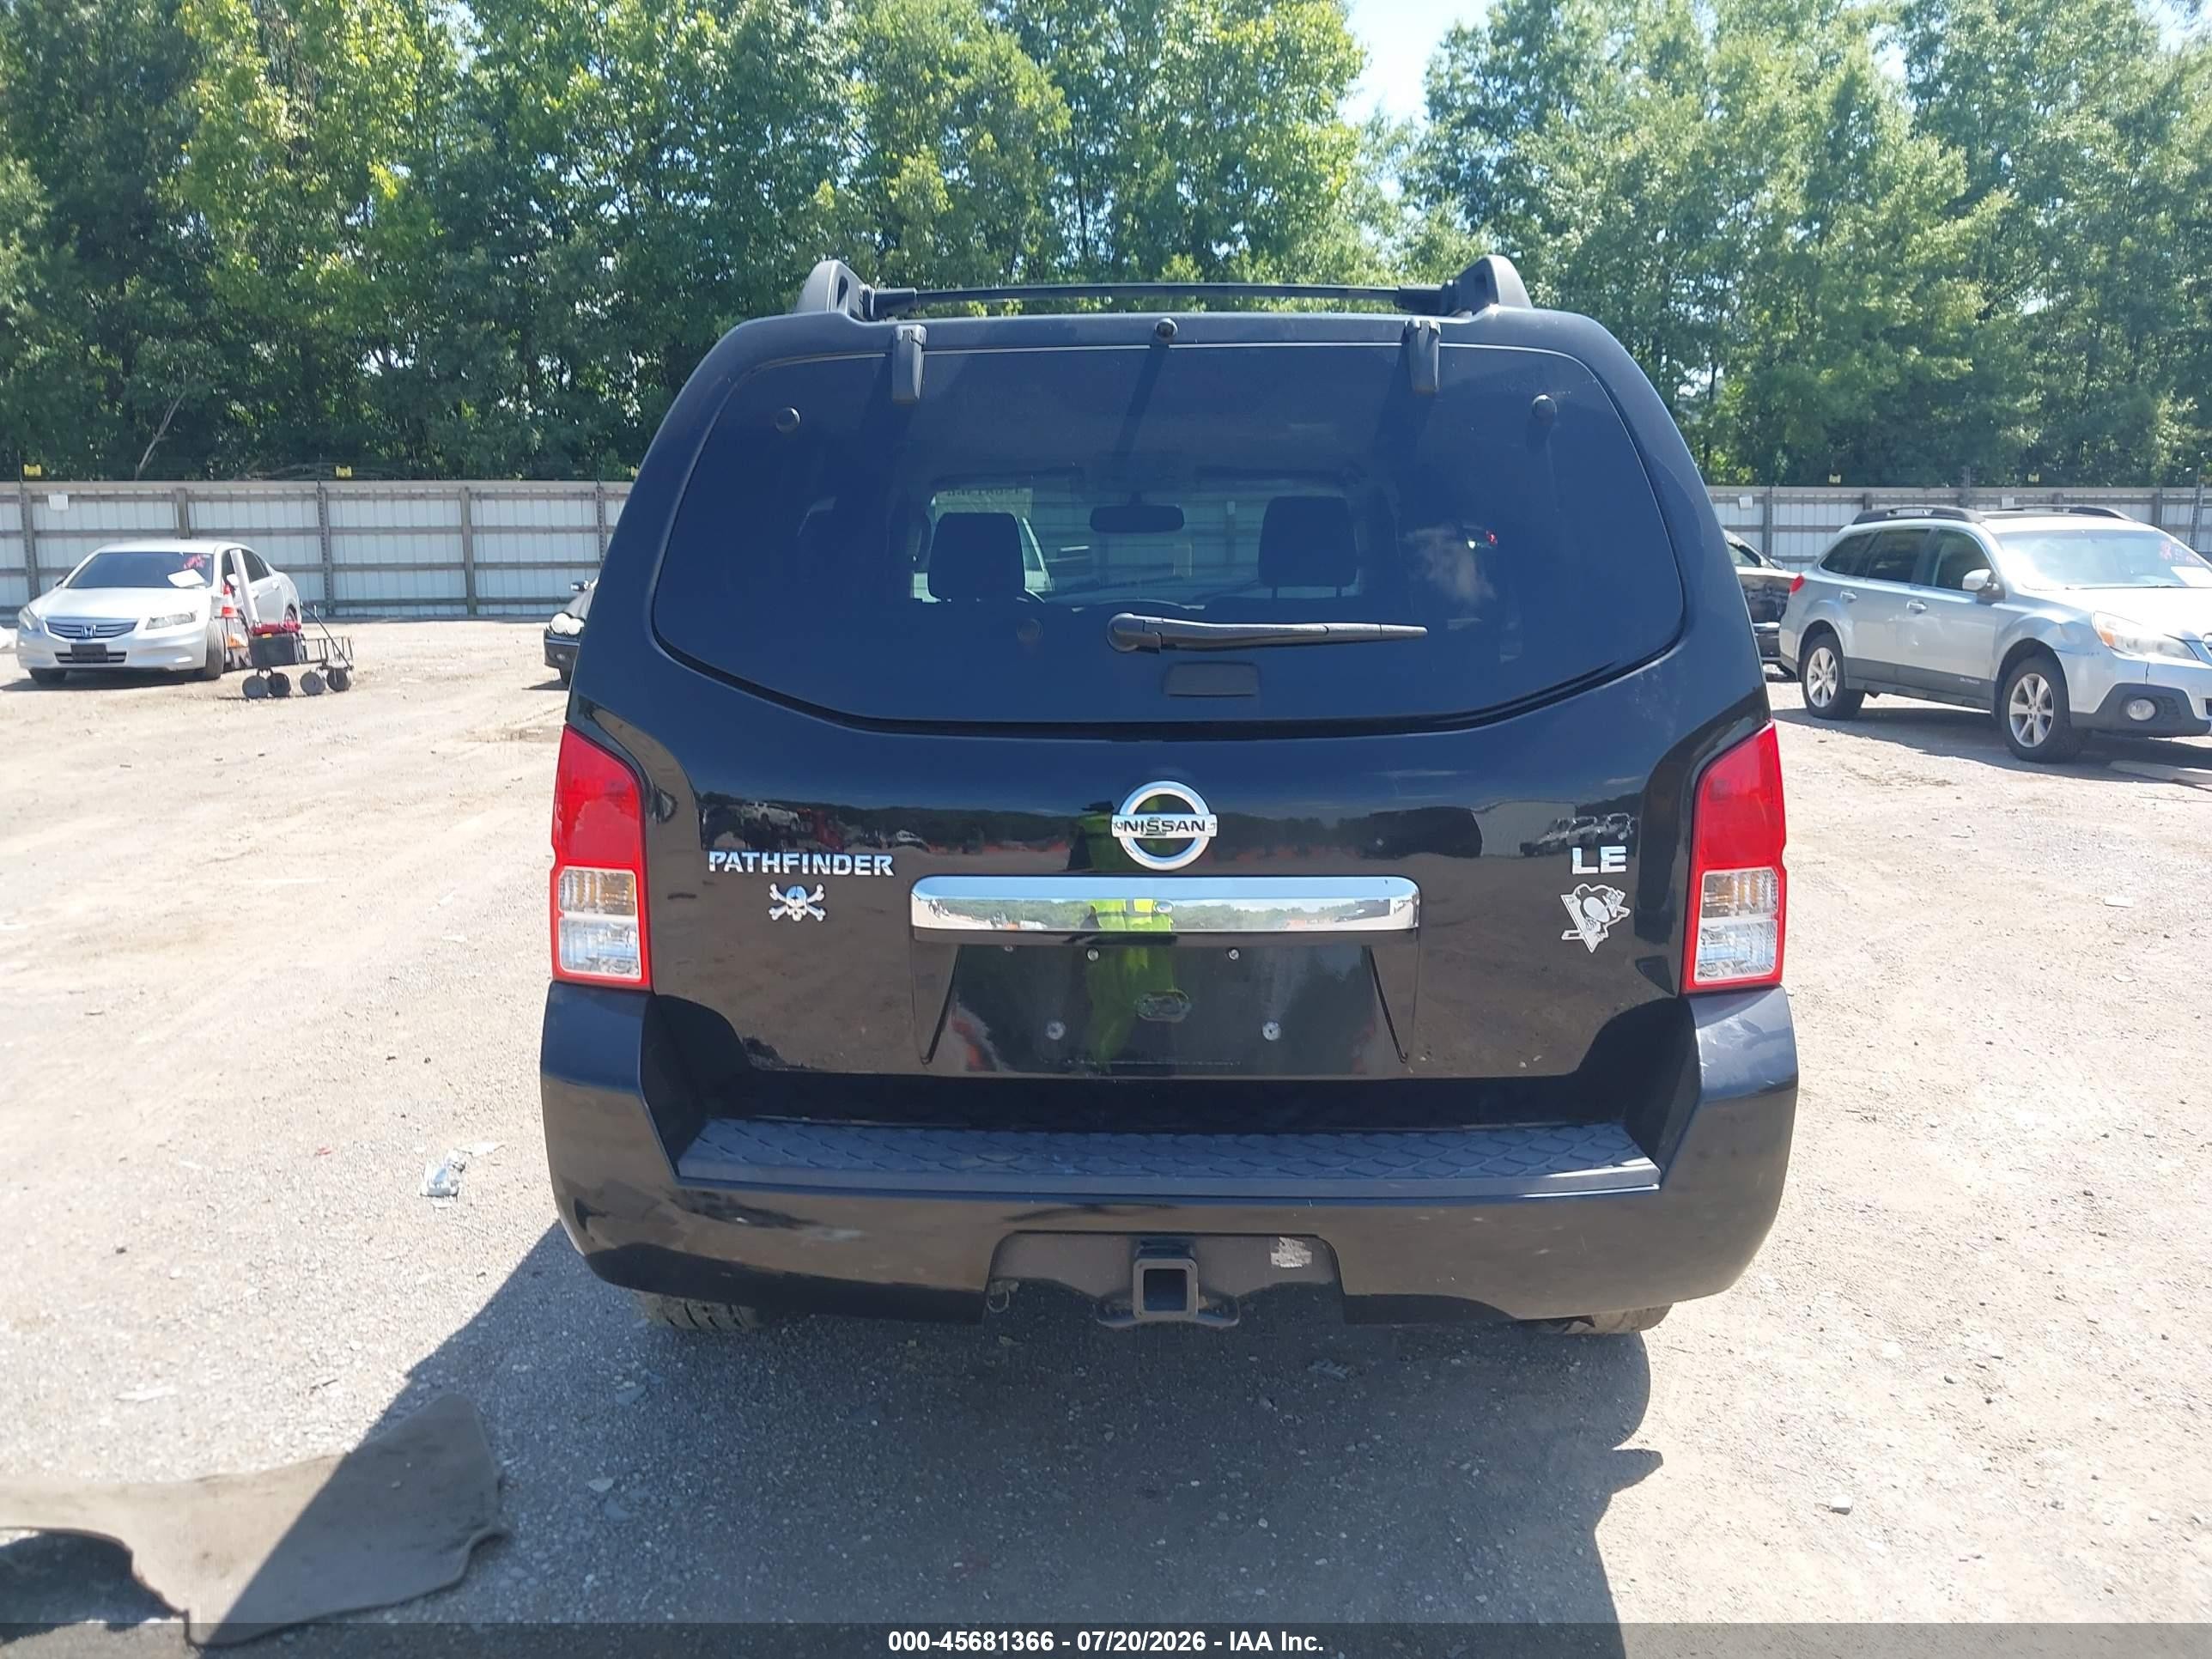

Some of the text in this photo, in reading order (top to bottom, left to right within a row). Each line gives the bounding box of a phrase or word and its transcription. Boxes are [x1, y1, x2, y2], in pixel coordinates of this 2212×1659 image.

[1123, 819, 1206, 832] NISSAN
[708, 850, 896, 876] PATHFINDER
[1571, 846, 1627, 874] LE
